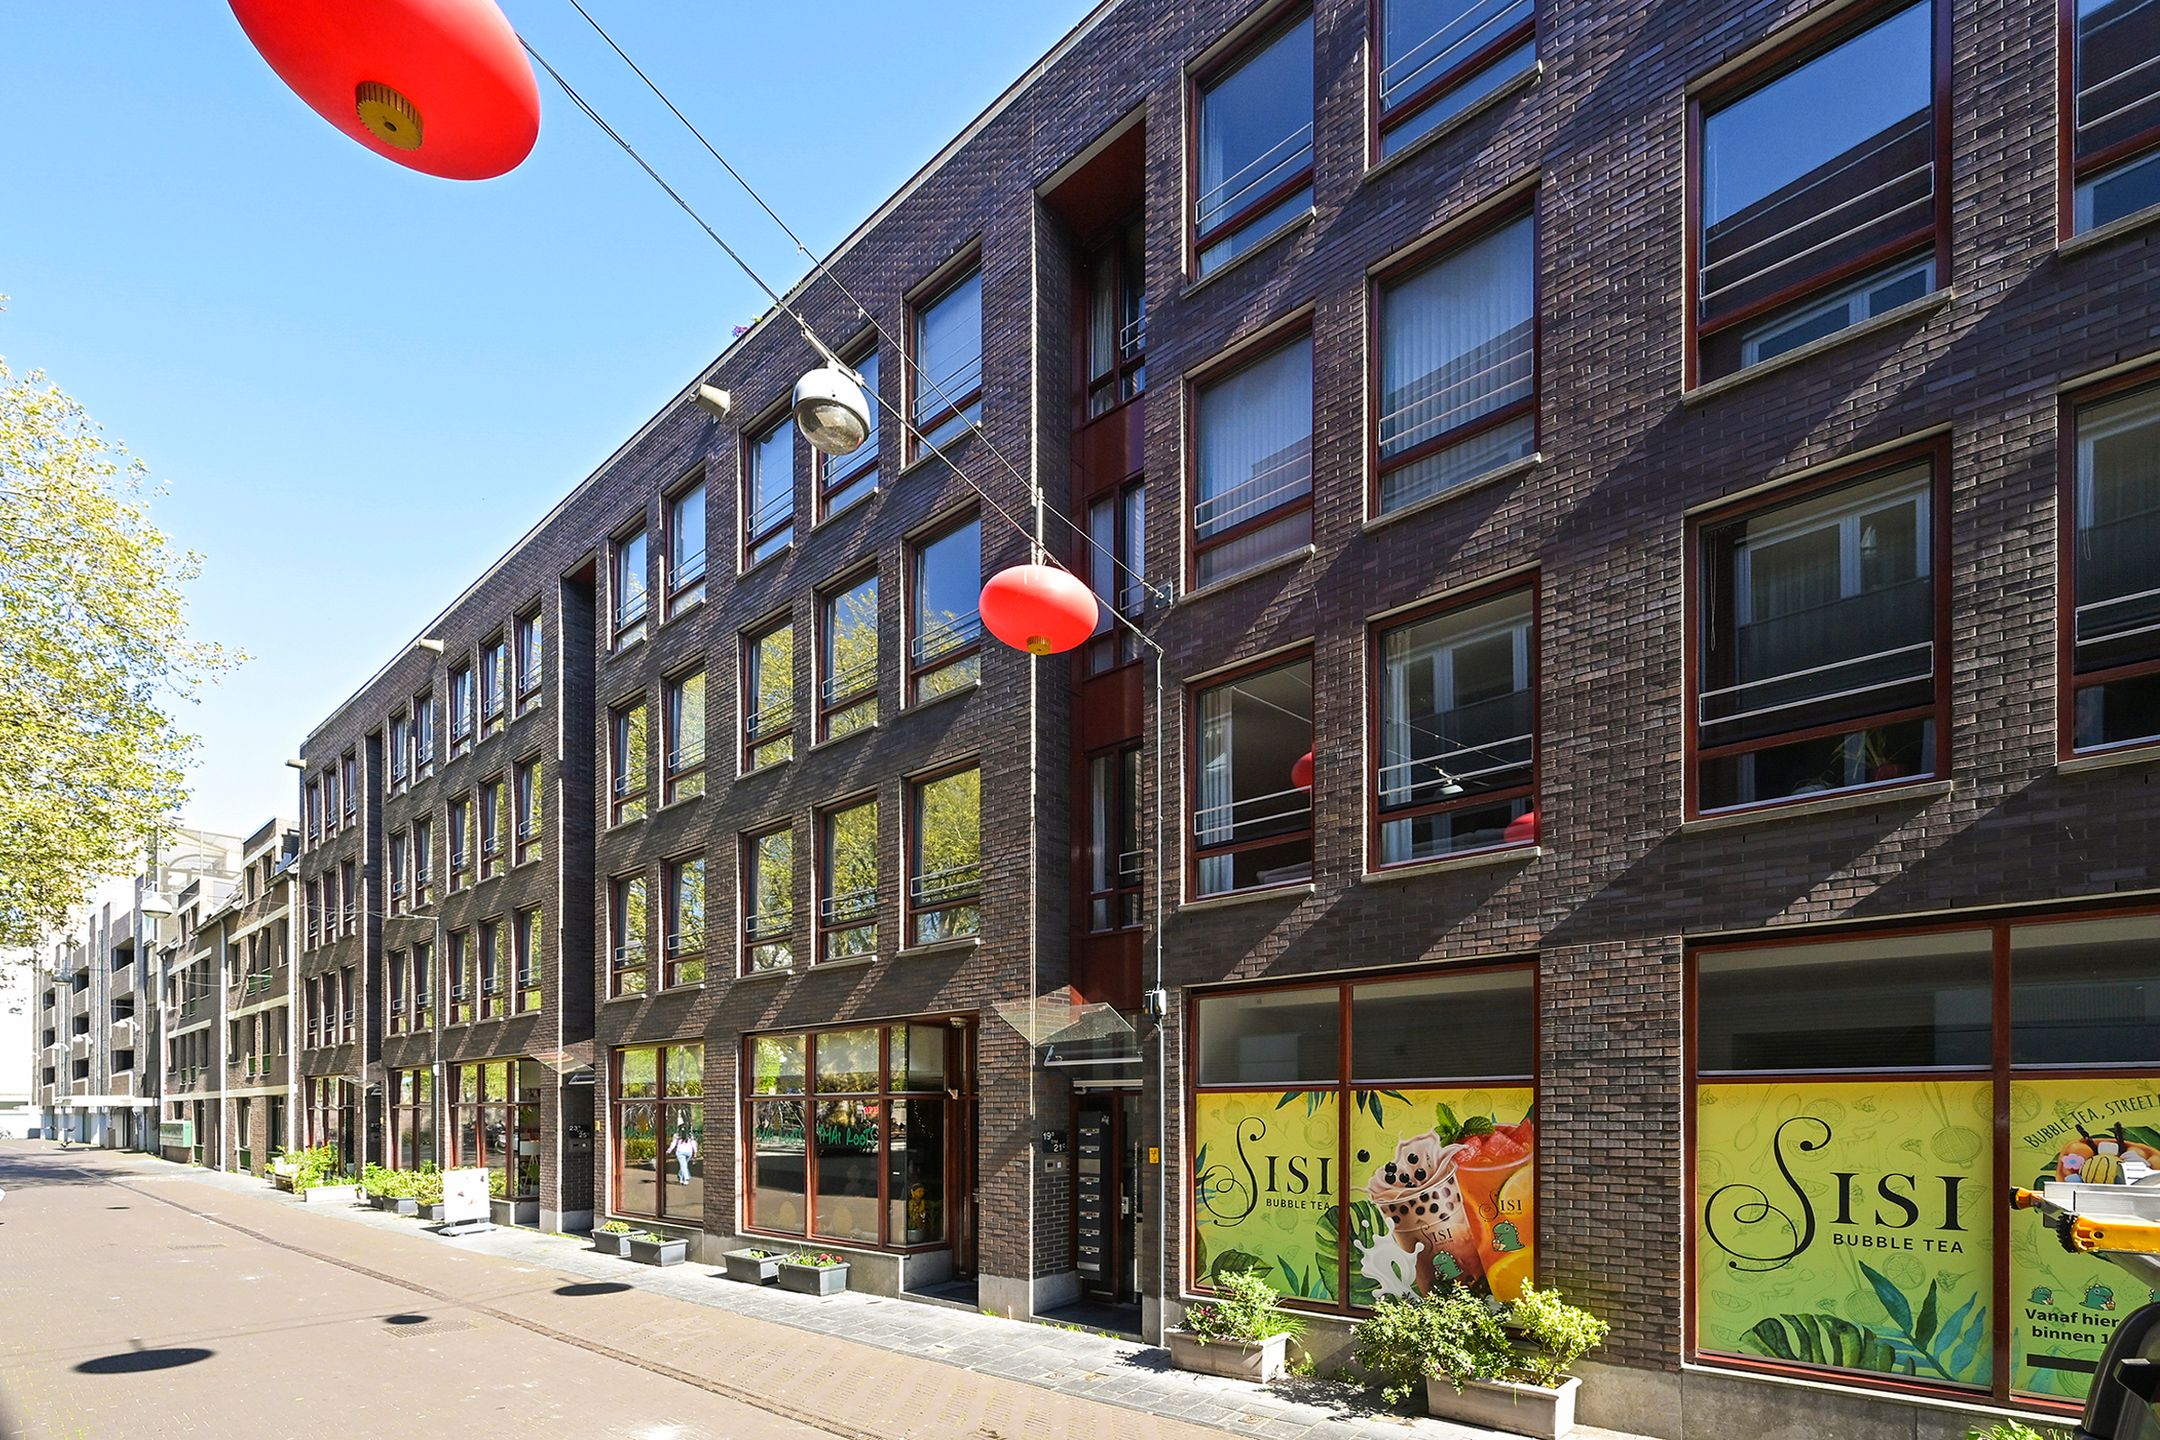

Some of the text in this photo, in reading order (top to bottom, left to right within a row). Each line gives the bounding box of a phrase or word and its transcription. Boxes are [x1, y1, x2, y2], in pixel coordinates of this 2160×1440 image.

[863, 1105, 879, 1116] OPE
[2023, 1115, 2076, 1149] BUBBLE
[2105, 1094, 2153, 1117] STREET
[1201, 1117, 1332, 1227] SISI
[1704, 1117, 1968, 1272] SISI
[1266, 1199, 1330, 1211] BUBBLE TEA
[1833, 1233, 1964, 1254] BUBBLE TEA
[2025, 1308, 2120, 1328] Vanaf hier
[2032, 1325, 2109, 1345] binnen 1
